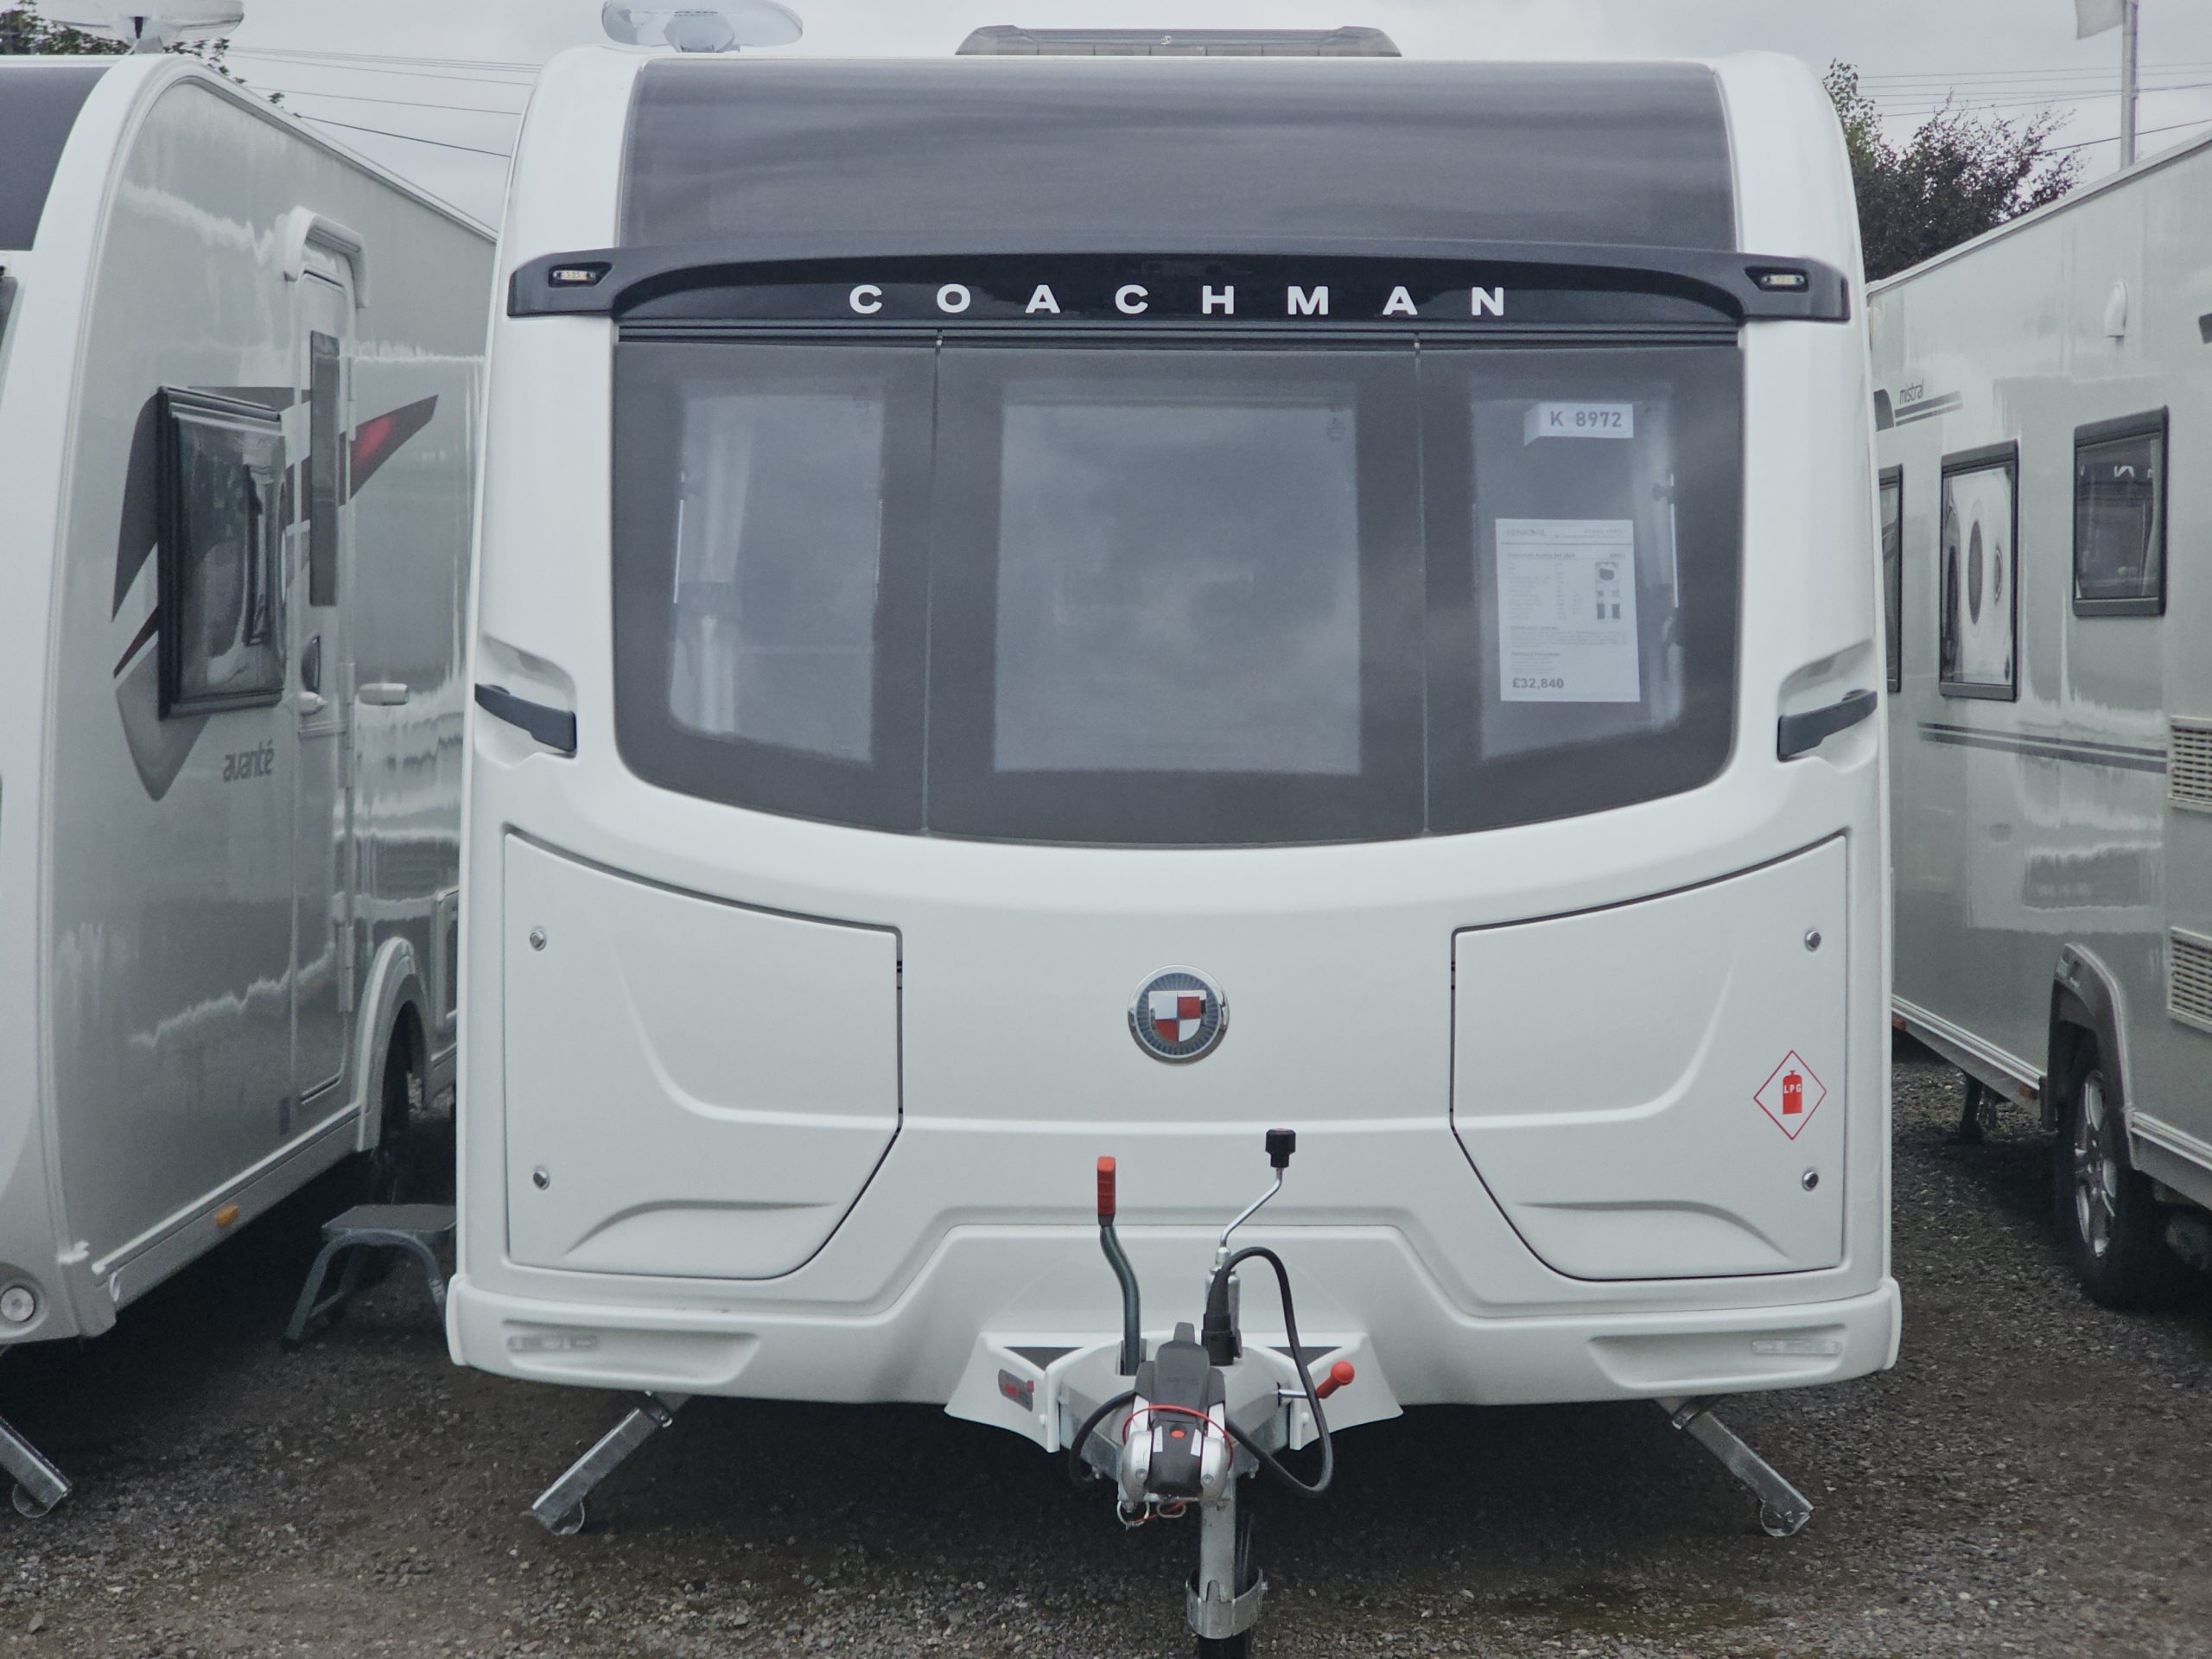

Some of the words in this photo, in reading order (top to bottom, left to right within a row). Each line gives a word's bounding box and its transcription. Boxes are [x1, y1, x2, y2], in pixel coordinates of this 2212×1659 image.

[849, 283, 1504, 316] COACHMAN
[1549, 410, 1563, 428] K
[1575, 410, 1623, 428] 8972
[1512, 677, 1565, 690] £32,840
[1783, 1084, 1802, 1094] LPG
